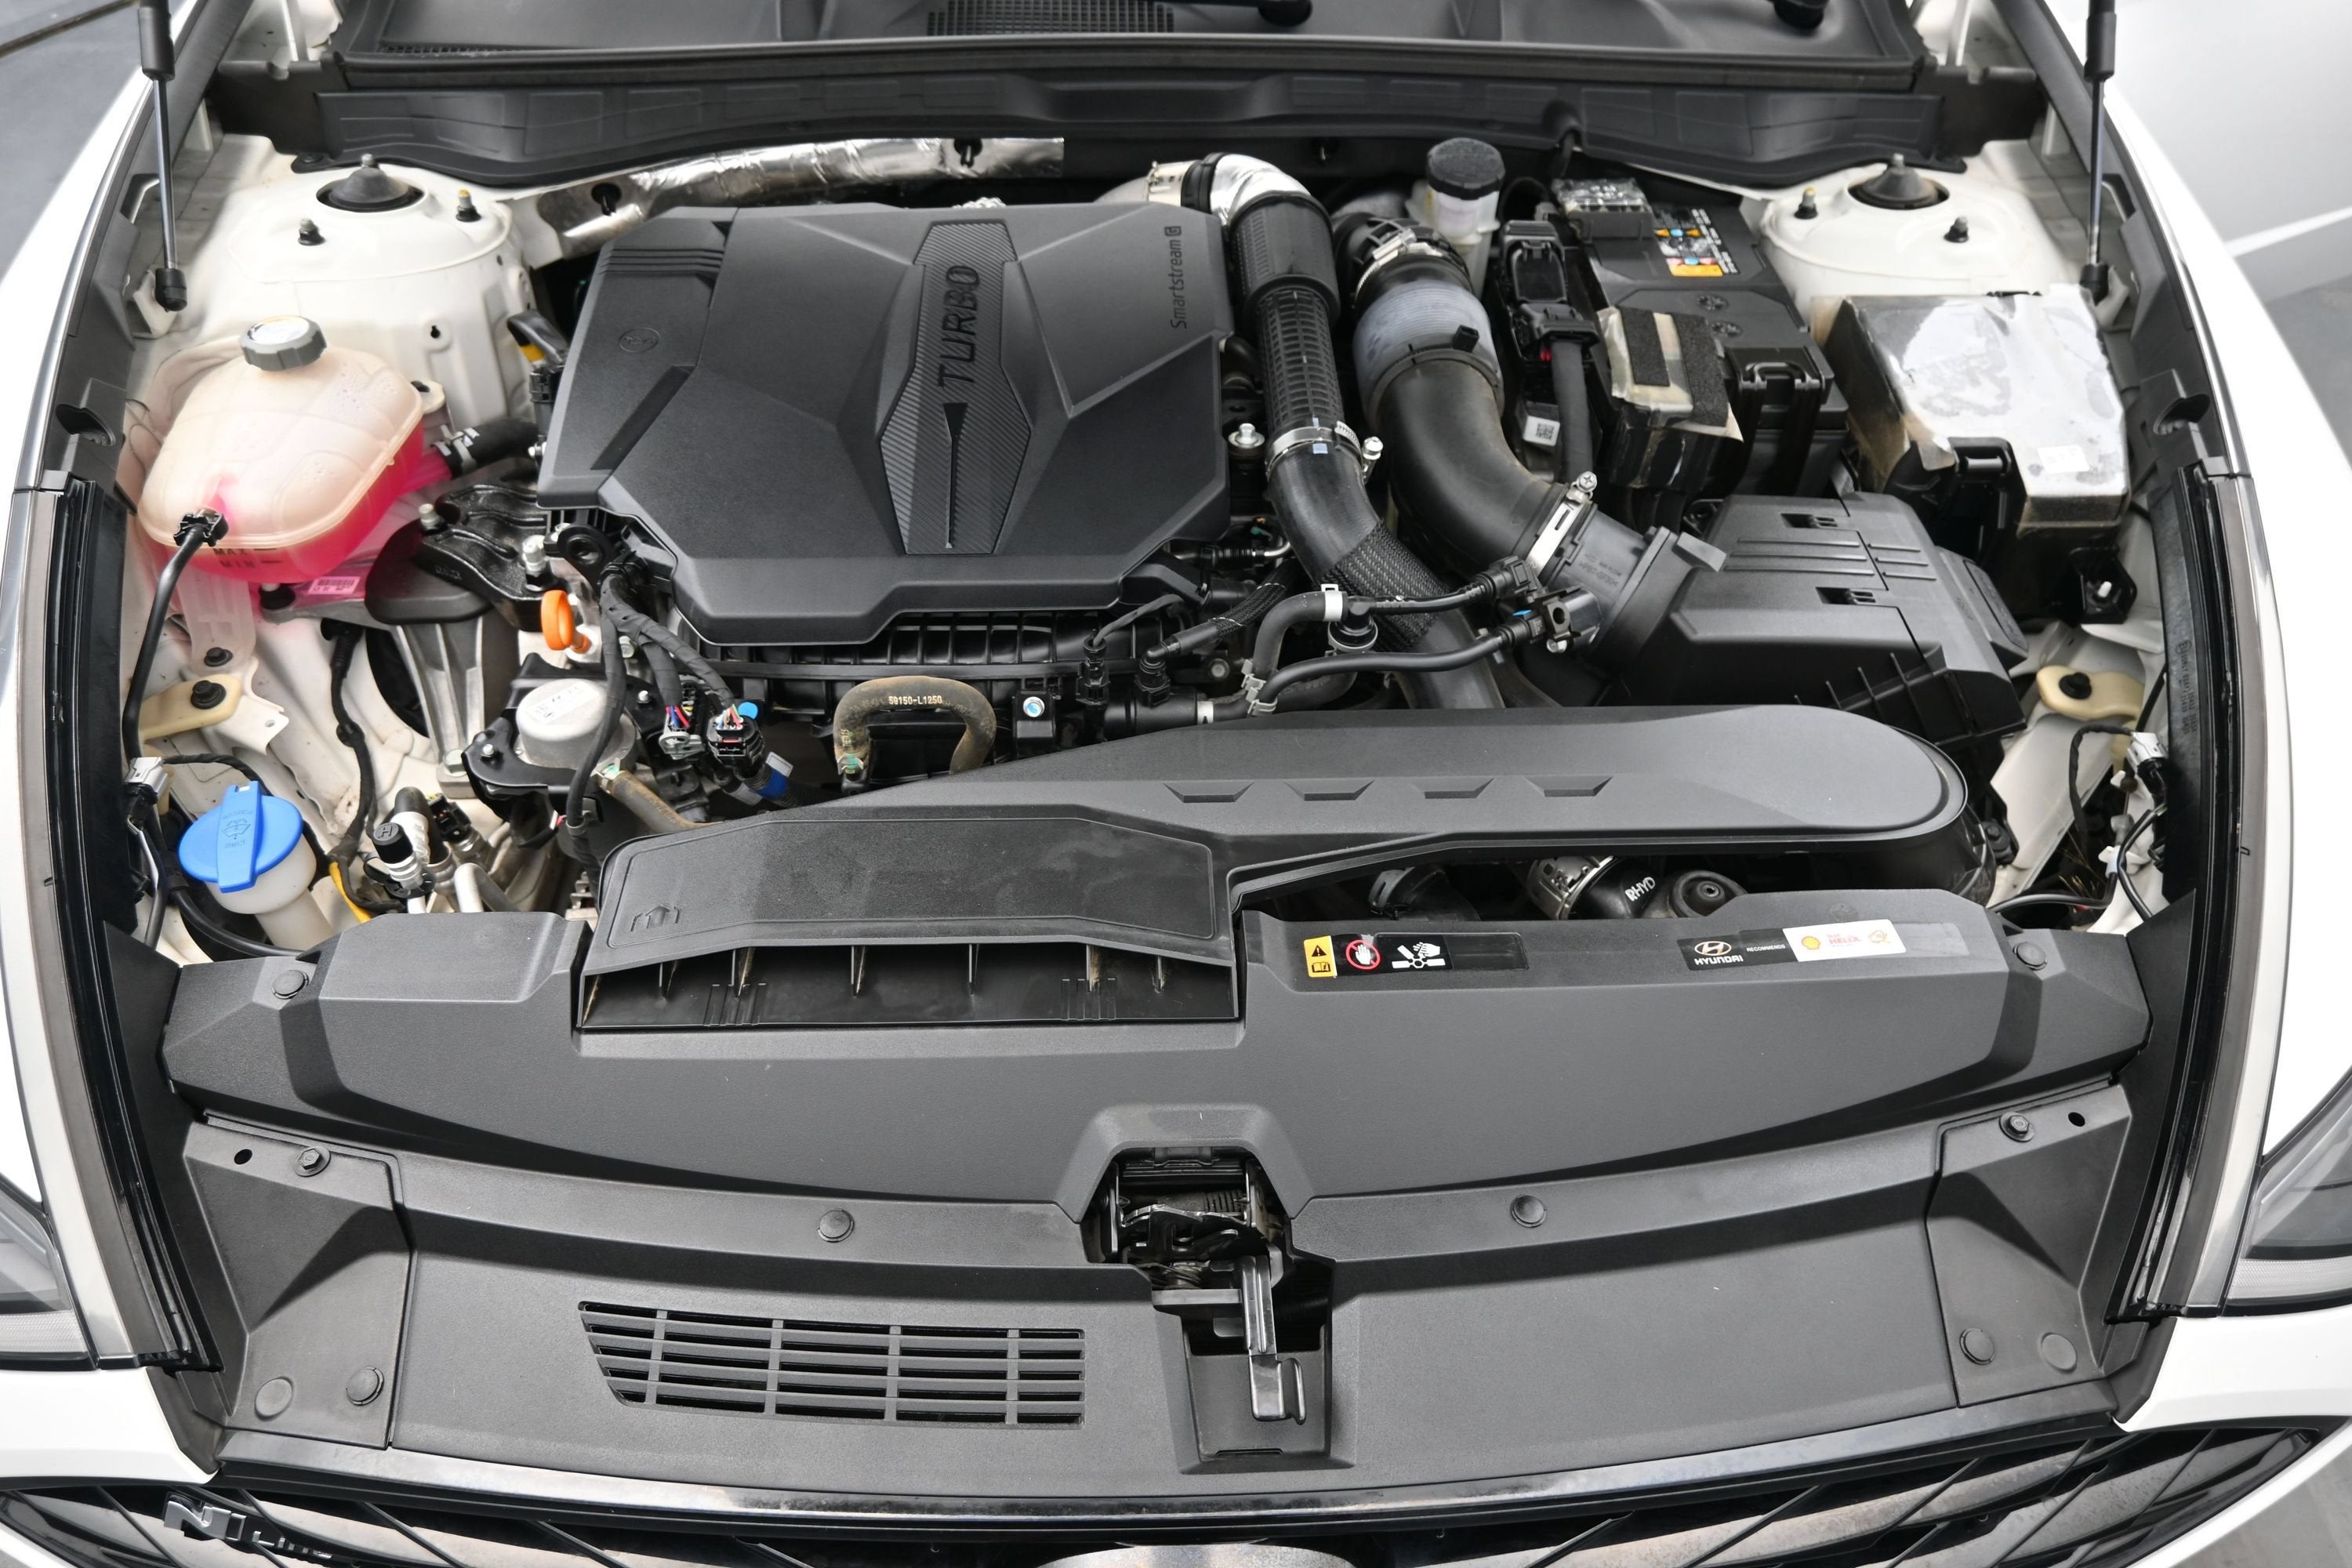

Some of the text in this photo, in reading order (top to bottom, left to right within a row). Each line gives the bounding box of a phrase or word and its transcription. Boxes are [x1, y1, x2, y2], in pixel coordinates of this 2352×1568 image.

[1167, 239, 1187, 329] Smartstream
[938, 265, 979, 388] TURBO
[219, 559, 256, 568] MIN
[887, 695, 943, 706] 59150-L1250
[1624, 877, 1656, 902] RHYD
[1746, 943, 1787, 953] RECOMMENDS
[1693, 954, 1744, 966] HYUNDAI
